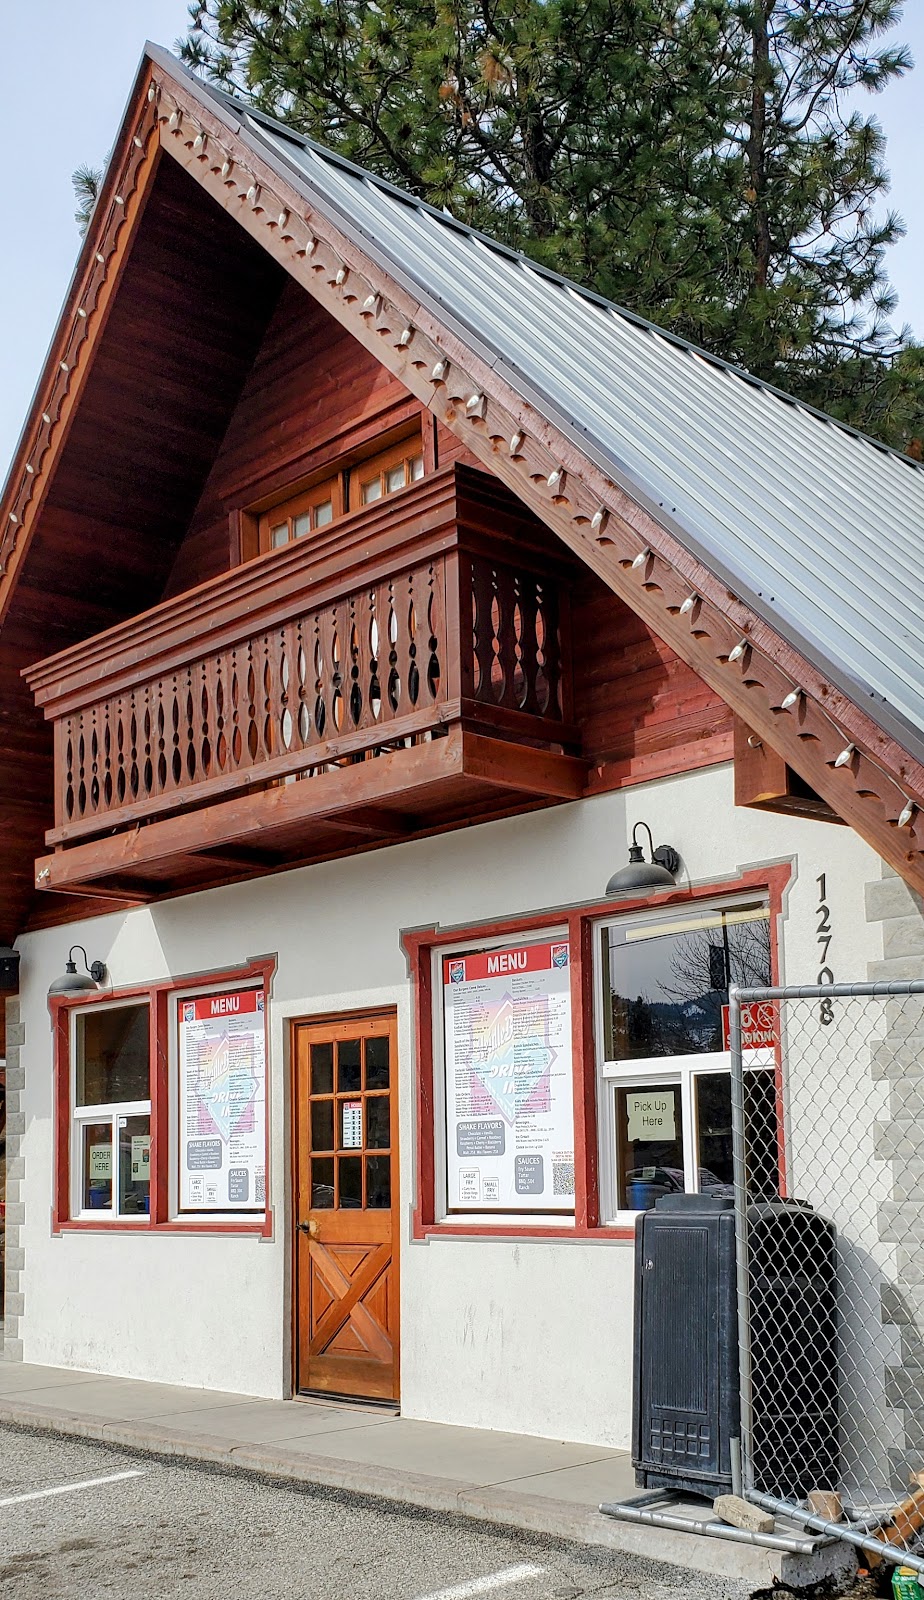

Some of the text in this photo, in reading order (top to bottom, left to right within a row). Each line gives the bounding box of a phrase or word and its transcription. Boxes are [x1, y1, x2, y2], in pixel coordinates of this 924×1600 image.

[487, 951, 528, 974] MENU
[210, 996, 240, 1015] MENU
[634, 1100, 667, 1112] Pick Up
[642, 1116, 663, 1126] Here
[92, 1151, 111, 1160] ORDER
[94, 1162, 110, 1171] HERE
